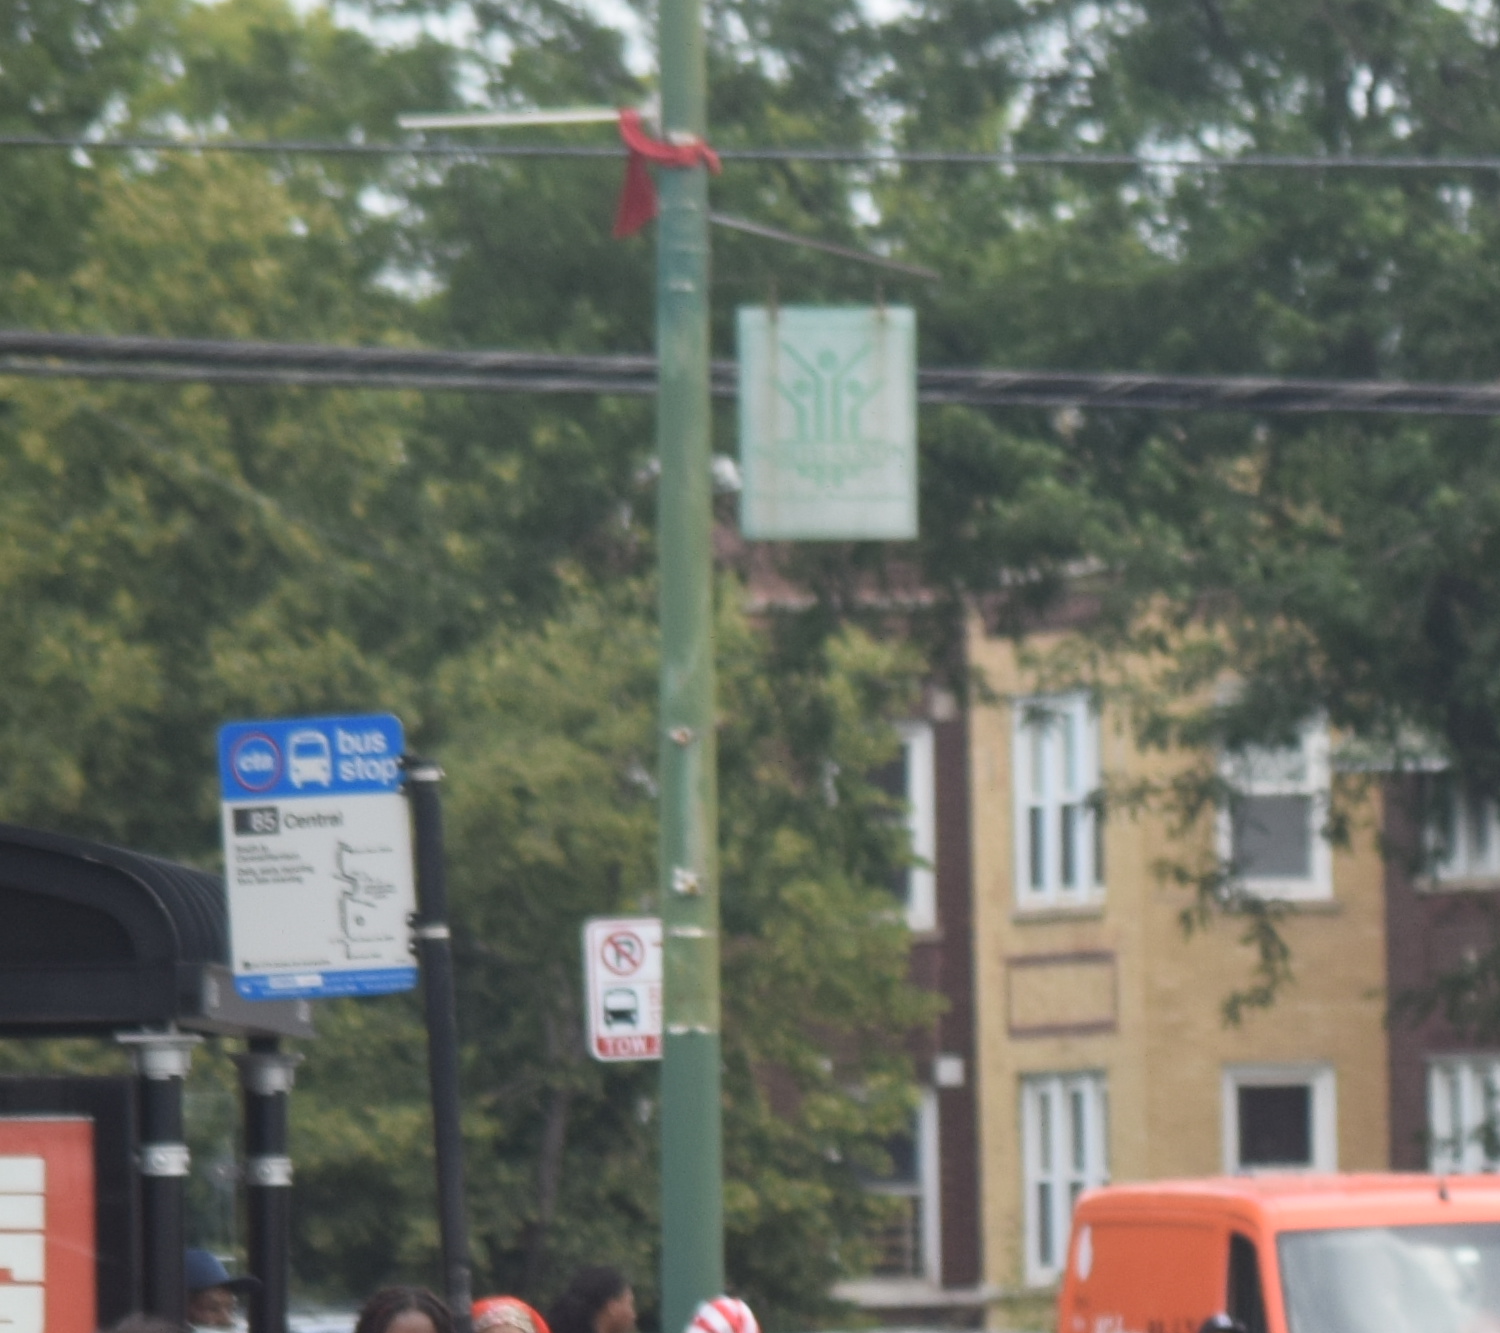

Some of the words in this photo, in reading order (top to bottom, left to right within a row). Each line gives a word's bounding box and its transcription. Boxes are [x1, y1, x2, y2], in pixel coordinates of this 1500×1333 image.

[335, 727, 388, 755] bus
[339, 755, 399, 786] stop
[283, 811, 343, 830] Central
[608, 1036, 646, 1056] TOW
